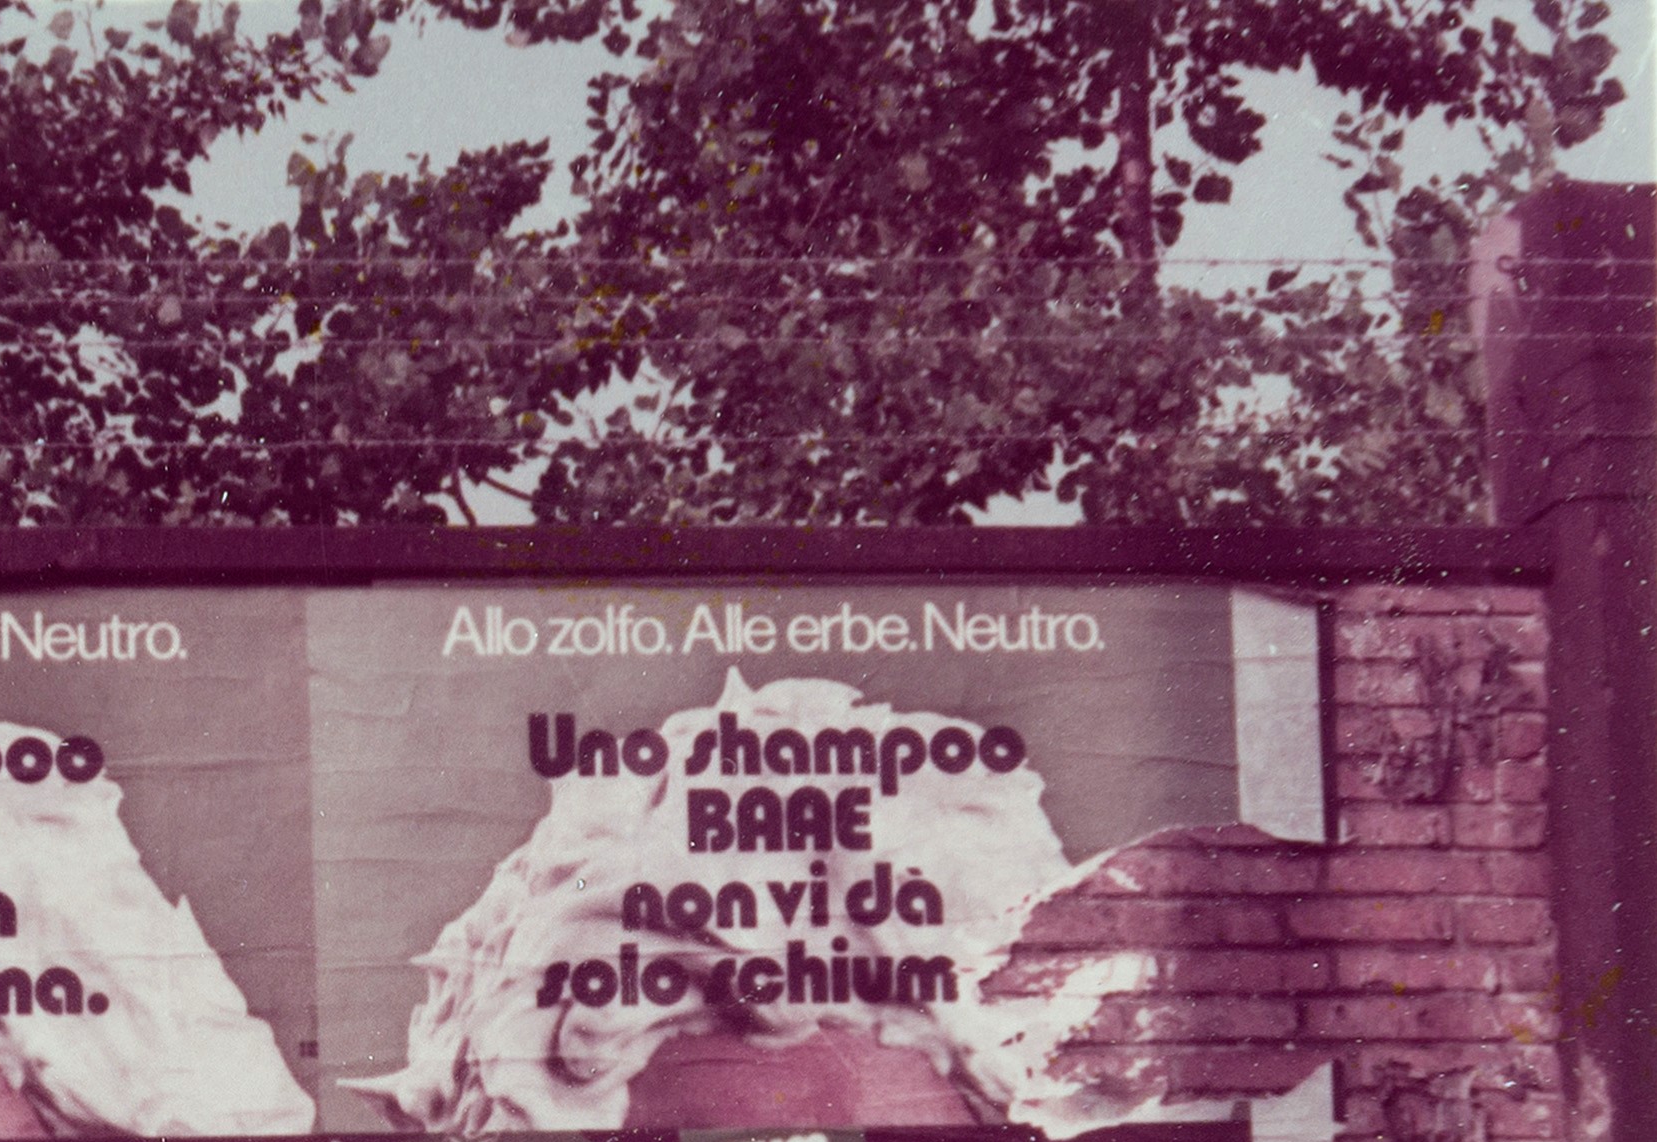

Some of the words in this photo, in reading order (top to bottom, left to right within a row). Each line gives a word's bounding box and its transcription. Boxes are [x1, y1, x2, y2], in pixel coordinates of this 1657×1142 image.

[0, 612, 188, 661] Neutro.
[443, 606, 538, 657] Allo
[547, 605, 674, 656] zolfo.
[682, 605, 778, 654] Alle
[787, 604, 919, 654] erbe.
[923, 602, 1105, 652] Neutro.
[528, 714, 669, 780] Uno
[684, 714, 1027, 796] shampoo
[686, 788, 873, 854] BAAE
[623, 880, 757, 931] non
[768, 860, 828, 930] vi
[845, 863, 944, 927] dà
[536, 944, 687, 1010] solo
